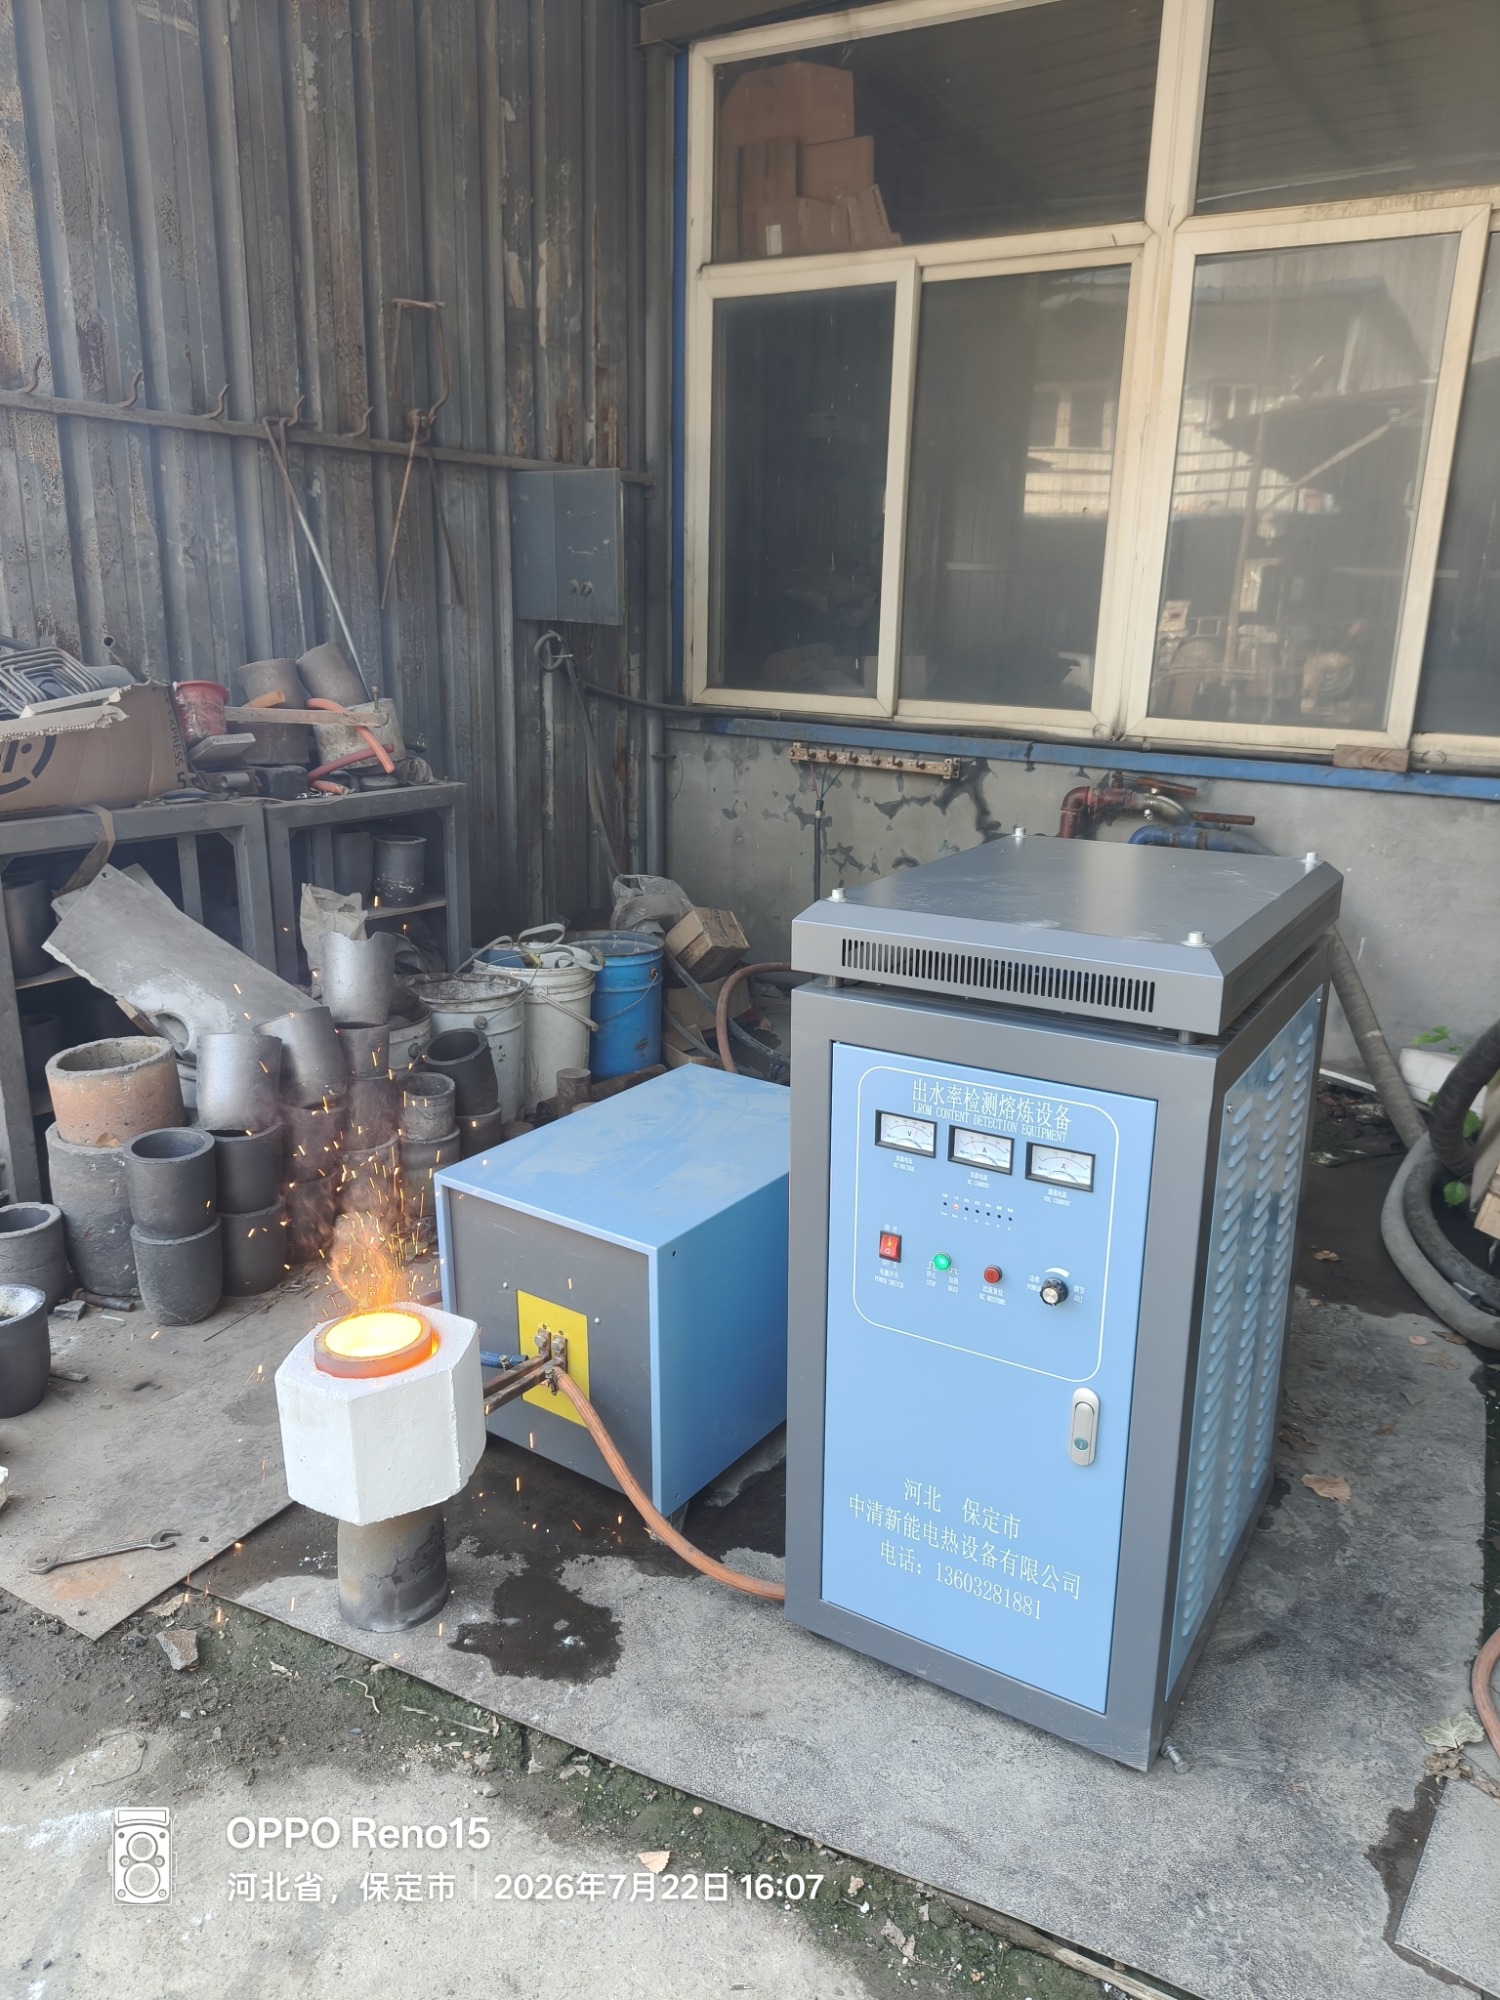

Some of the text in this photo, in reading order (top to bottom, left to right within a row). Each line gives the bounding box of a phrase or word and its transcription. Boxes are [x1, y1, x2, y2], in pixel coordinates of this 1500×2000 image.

[912, 1077, 1072, 1131] 出水率检测熔炼设备
[936, 1107, 970, 1124] CONTENT
[973, 1114, 1018, 1133] DETECTION
[1021, 1124, 1067, 1143] EQUIPMENT
[903, 1477, 1021, 1540] 河北 保定市
[849, 1493, 1081, 1601] 中清新能电热设备有限公司
[935, 1562, 1042, 1621] 13603281881
